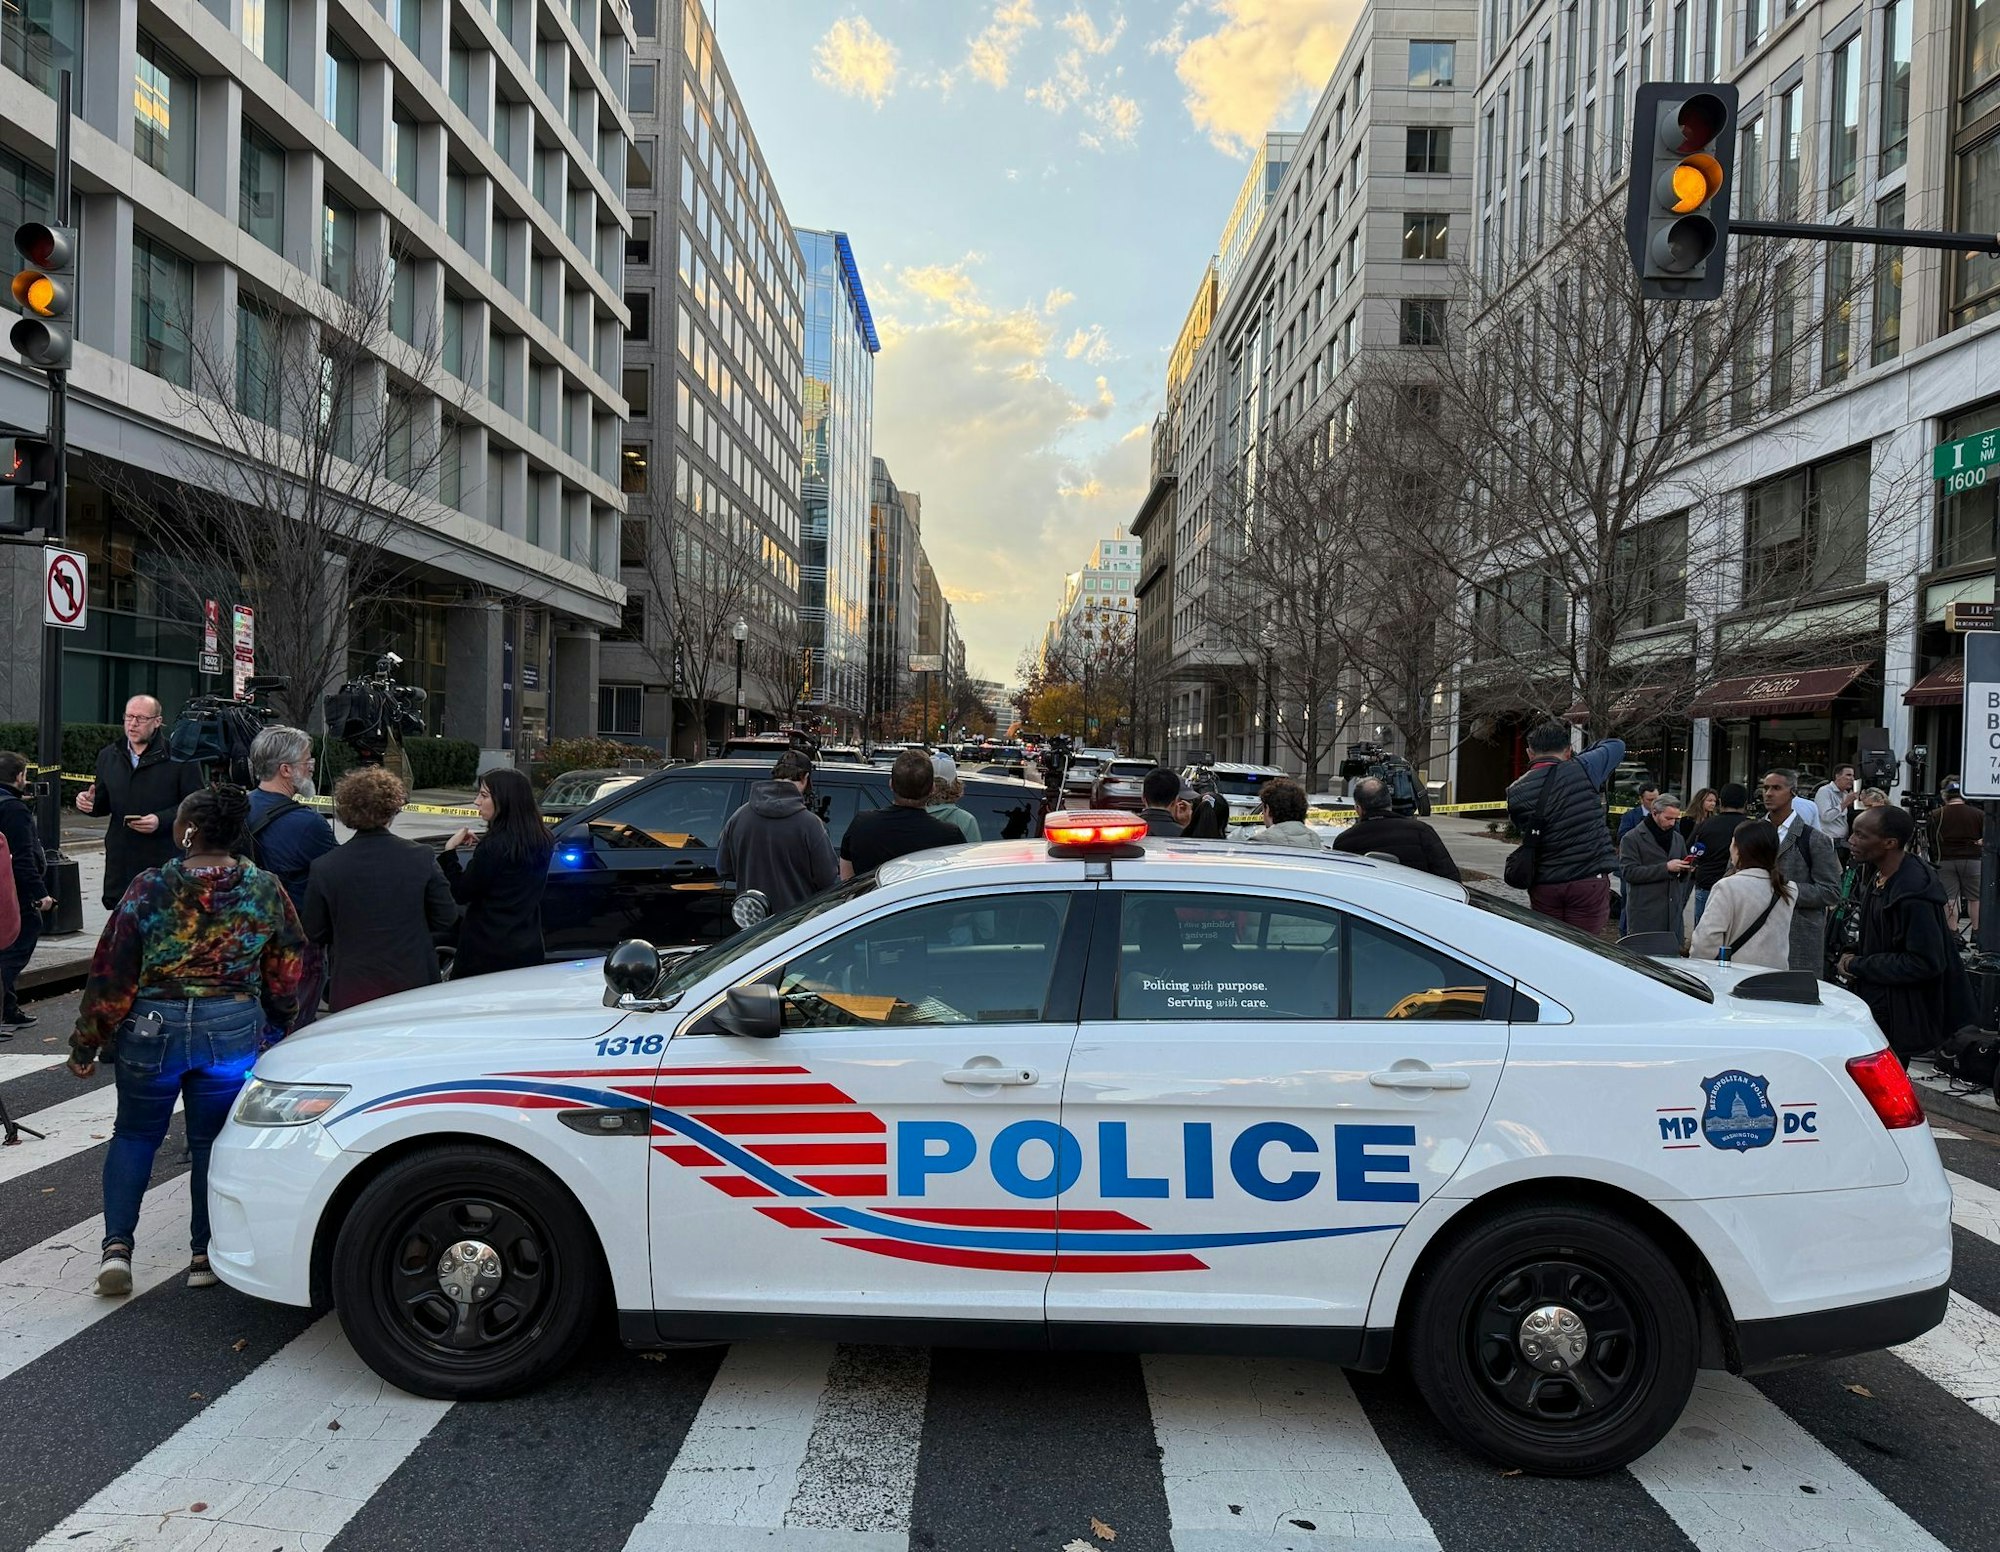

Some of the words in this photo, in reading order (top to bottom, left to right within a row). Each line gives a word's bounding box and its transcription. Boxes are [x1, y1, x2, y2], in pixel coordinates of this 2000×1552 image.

[1952, 443, 1964, 469] I
[1982, 435, 1995, 448] ST
[1980, 448, 1996, 461] NW
[1948, 467, 1985, 491] 1600
[1971, 606, 1983, 614] IL
[1143, 980, 1189, 993] Policing
[1192, 981, 1214, 991] with
[1217, 982, 1268, 993] purpose.
[1167, 997, 1213, 1009] Serving
[1216, 998, 1238, 1008] with
[1240, 999, 1269, 1008] care.
[595, 1034, 664, 1056] 1318
[1710, 1074, 1749, 1111] METROPOLITAN
[1750, 1081, 1768, 1109] POLICE
[1658, 1117, 1698, 1140] MP
[1783, 1111, 1818, 1134] DC
[1721, 1132, 1759, 1142] WASHINGTON
[897, 1120, 1420, 1203] POLICE
